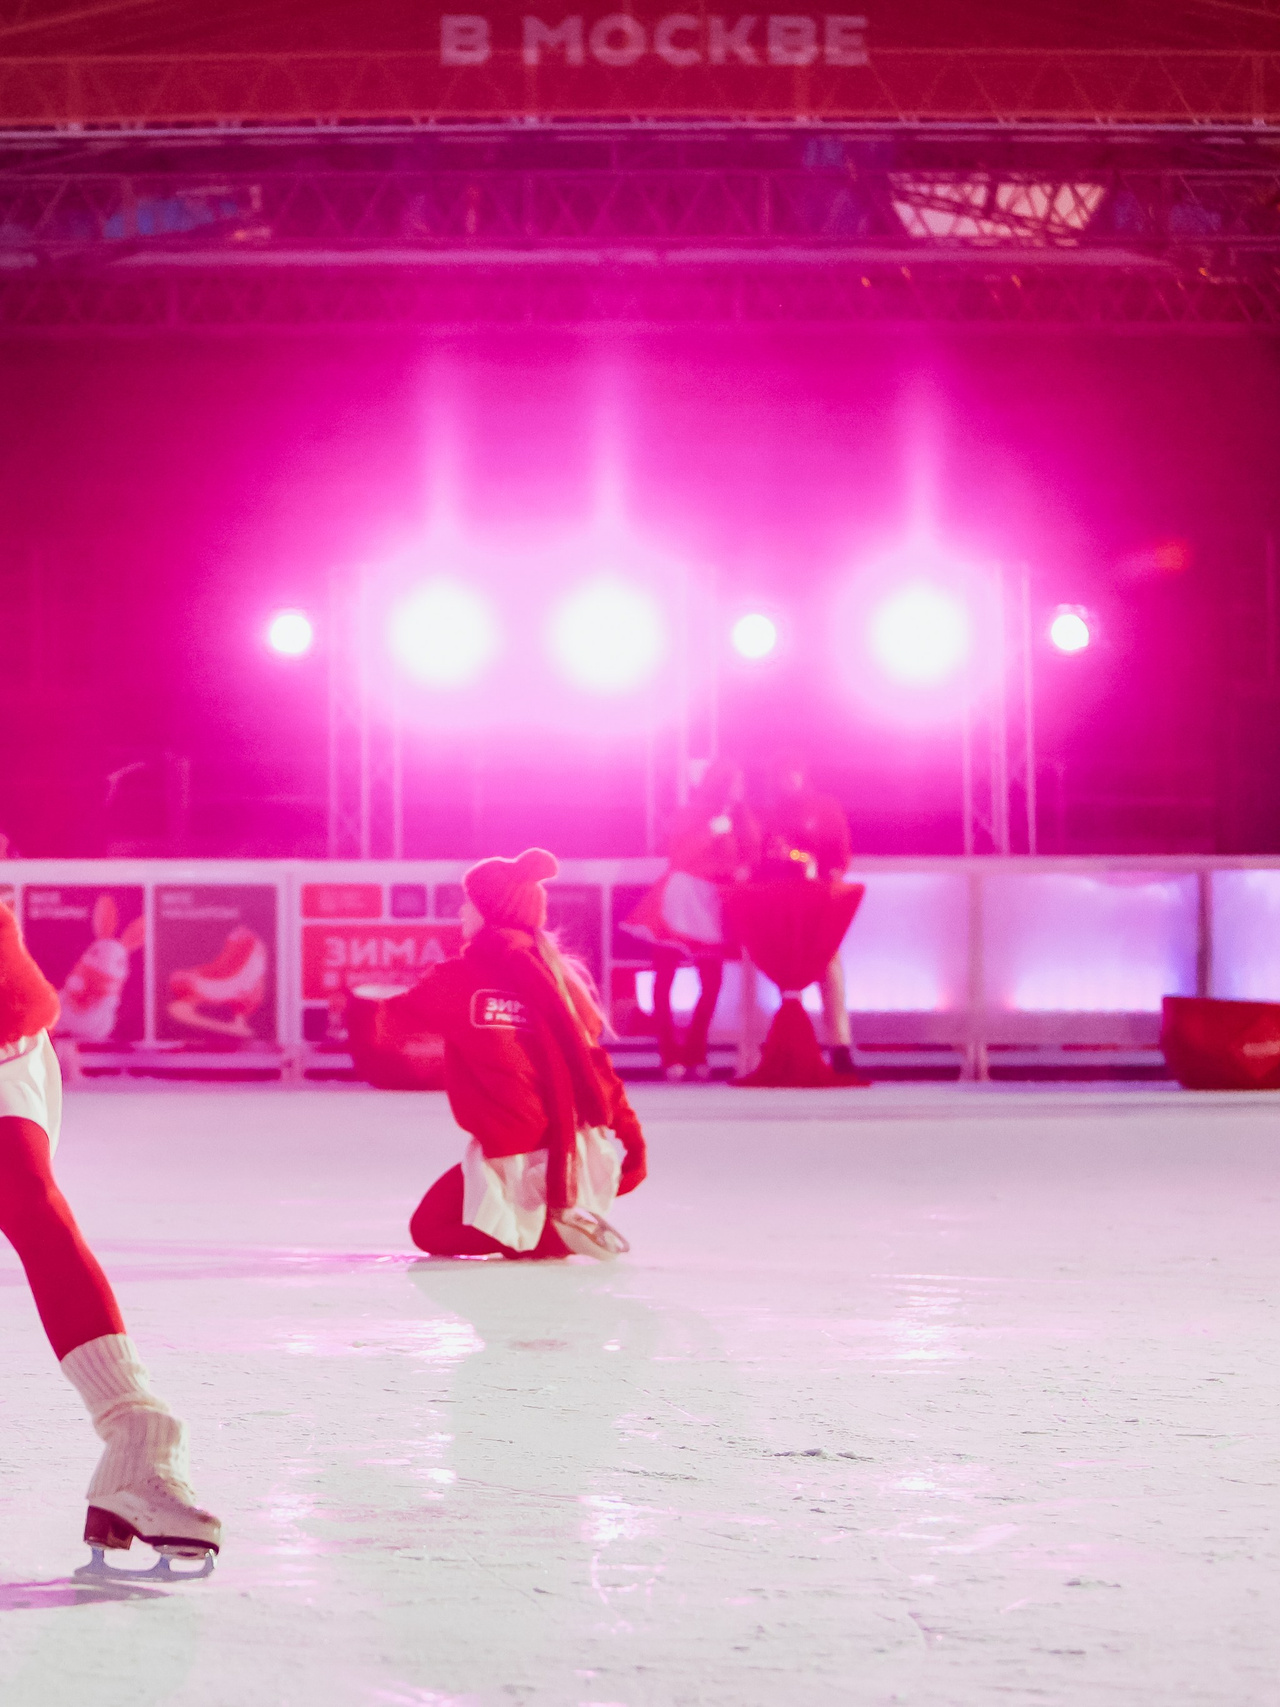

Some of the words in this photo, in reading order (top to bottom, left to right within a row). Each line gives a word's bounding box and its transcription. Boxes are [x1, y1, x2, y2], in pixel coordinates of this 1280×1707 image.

[440, 14, 490, 66] В
[522, 13, 869, 67] МОСКВЕ
[323, 937, 446, 966] ЗИМА
